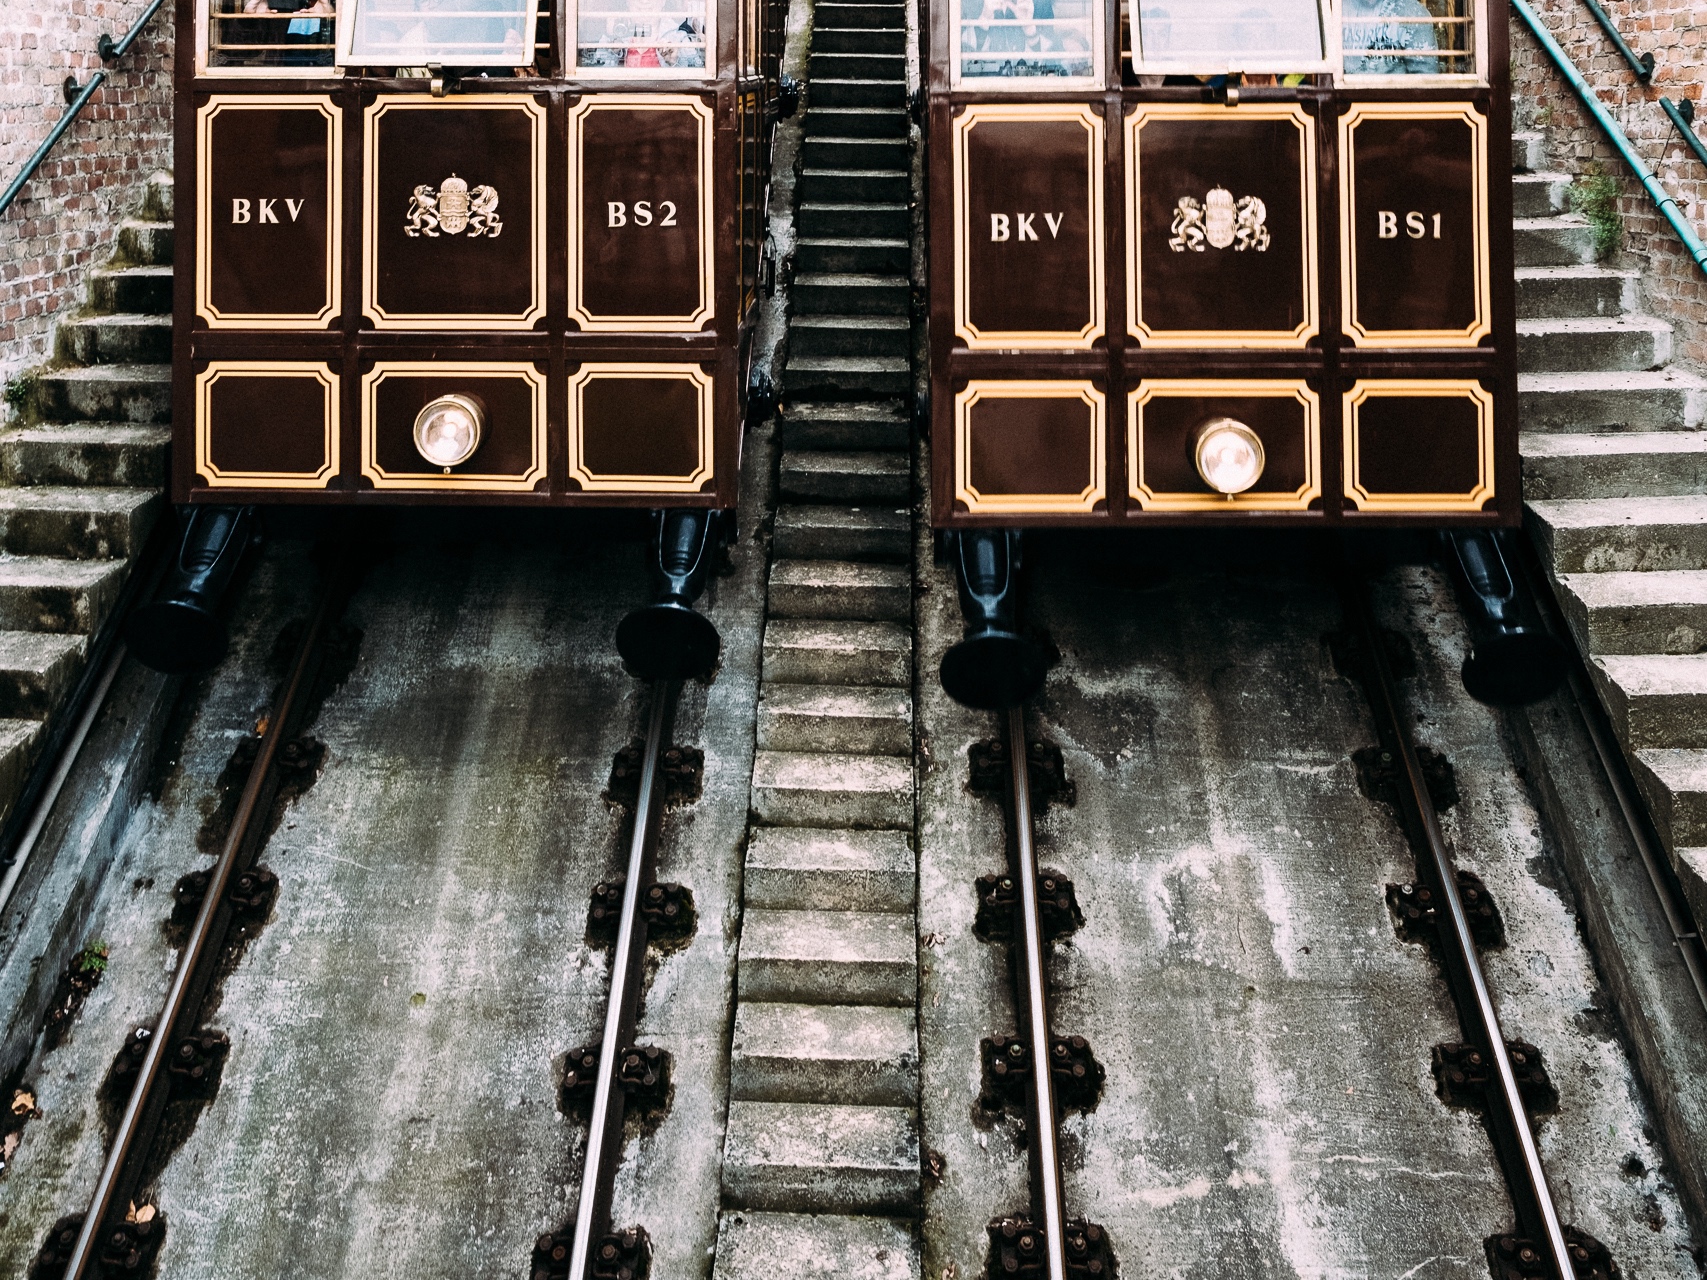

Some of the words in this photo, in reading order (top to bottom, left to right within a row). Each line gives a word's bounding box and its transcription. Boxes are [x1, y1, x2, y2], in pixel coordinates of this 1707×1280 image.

[231, 198, 305, 224] BKV
[607, 200, 677, 228] BS2
[1378, 210, 1441, 240] BS1
[990, 211, 1065, 242] BKV
